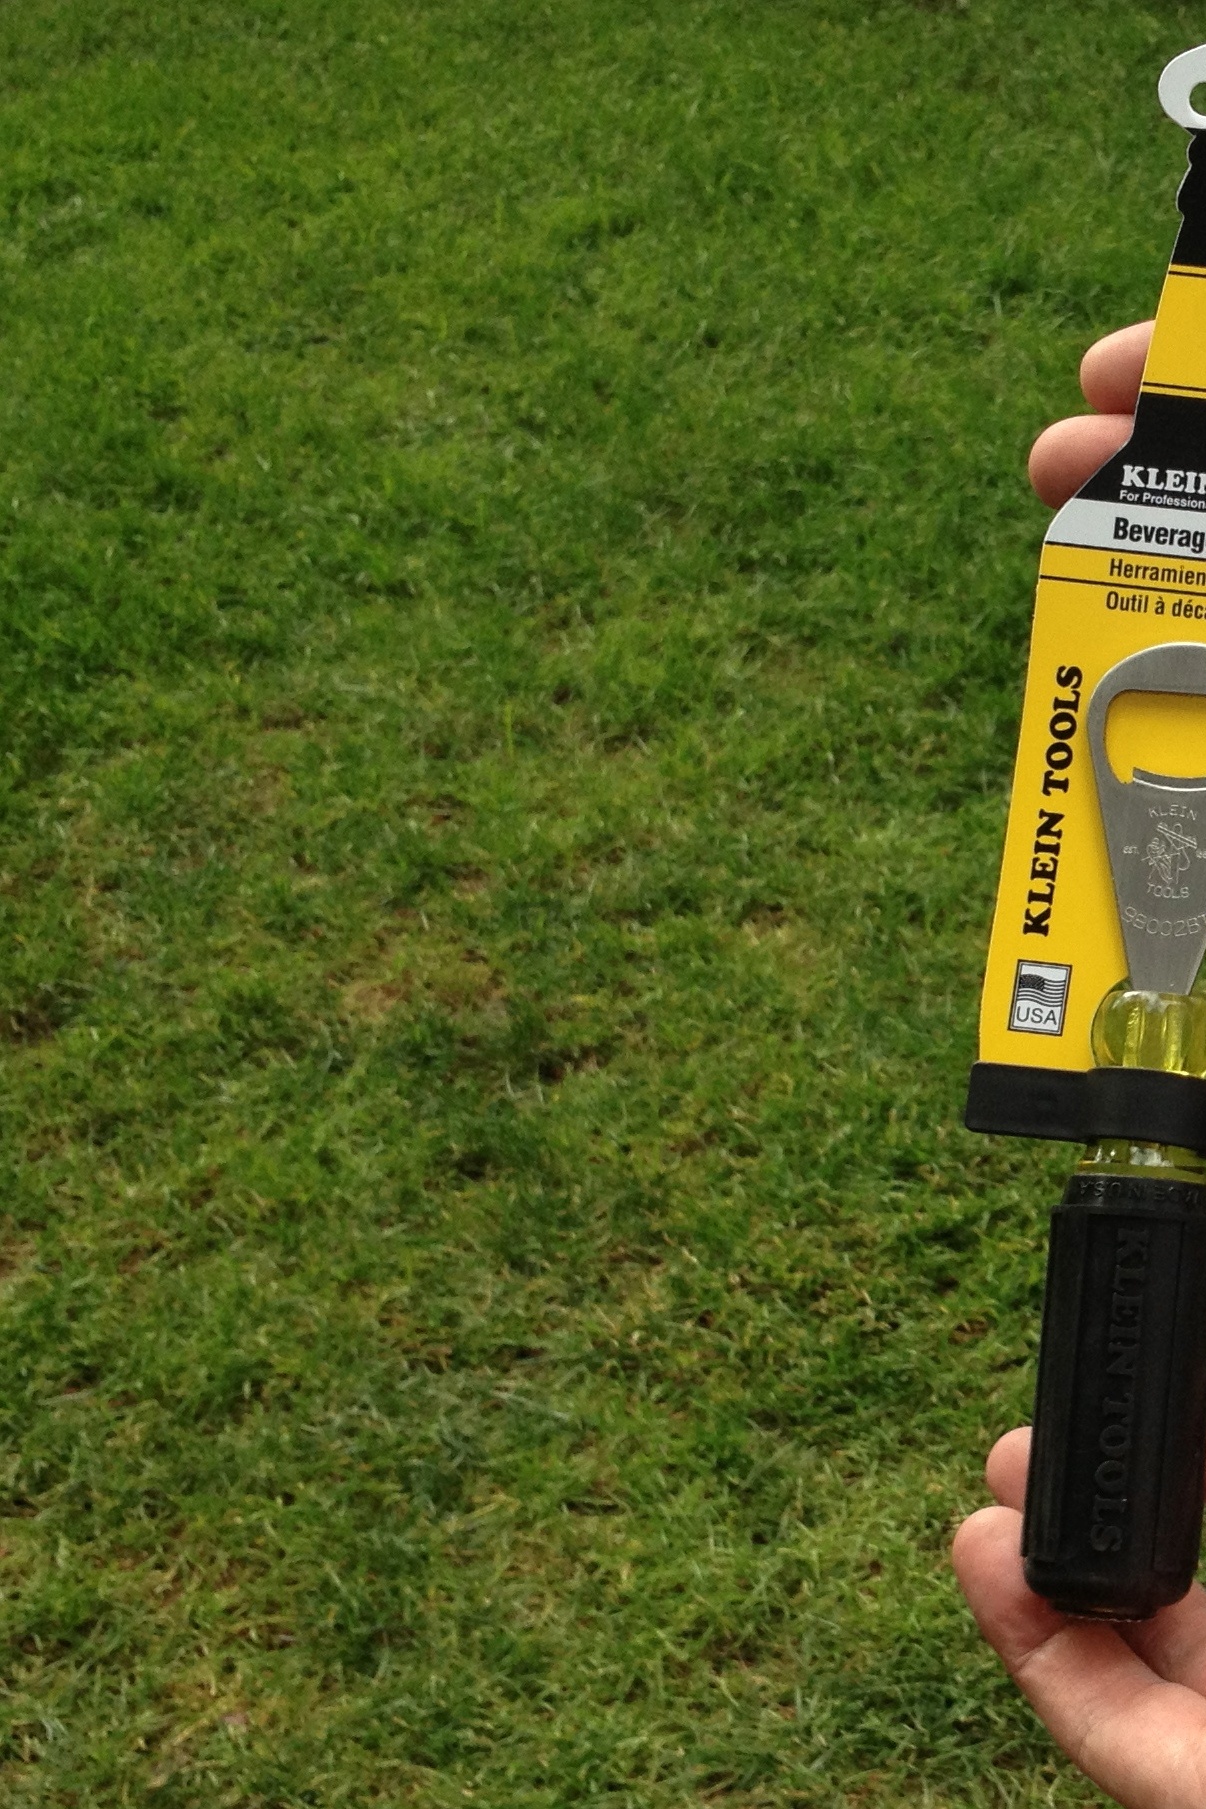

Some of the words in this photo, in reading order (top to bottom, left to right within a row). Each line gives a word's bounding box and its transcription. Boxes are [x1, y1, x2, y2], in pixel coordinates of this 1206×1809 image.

[1119, 489, 1141, 503] For
[1105, 591, 1149, 614] Outil
[1154, 596, 1166, 616] à
[1041, 665, 1084, 797] TOOLS
[1148, 804, 1198, 821] KLEIN
[1022, 809, 1066, 938] KLEIN
[1146, 882, 1191, 899] TOOLS
[1015, 1003, 1058, 1027] USA
[1105, 1227, 1151, 1379] KLEIN
[1090, 1391, 1136, 1552] TOOLS
